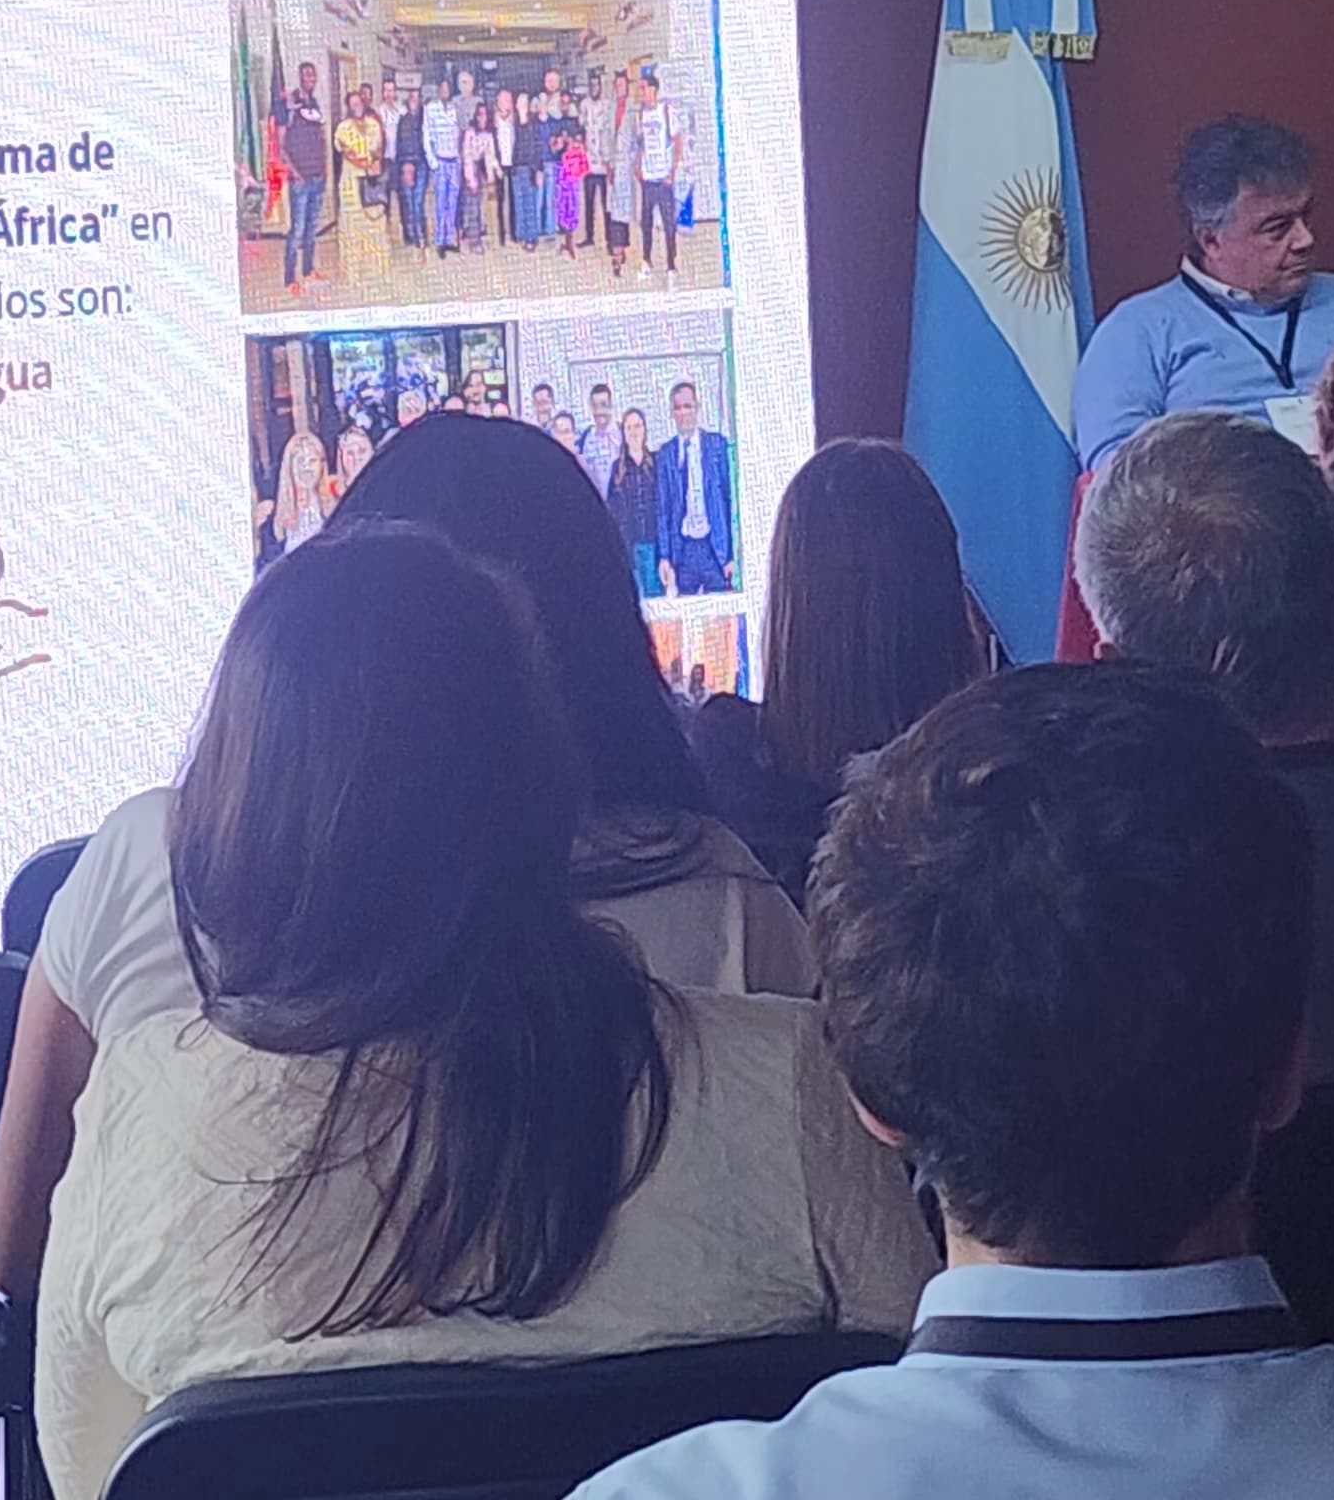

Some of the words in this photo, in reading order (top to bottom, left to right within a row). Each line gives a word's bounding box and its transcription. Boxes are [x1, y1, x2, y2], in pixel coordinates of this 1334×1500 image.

[67, 131, 116, 172] de
[129, 209, 174, 242] en
[58, 284, 132, 318] son:
